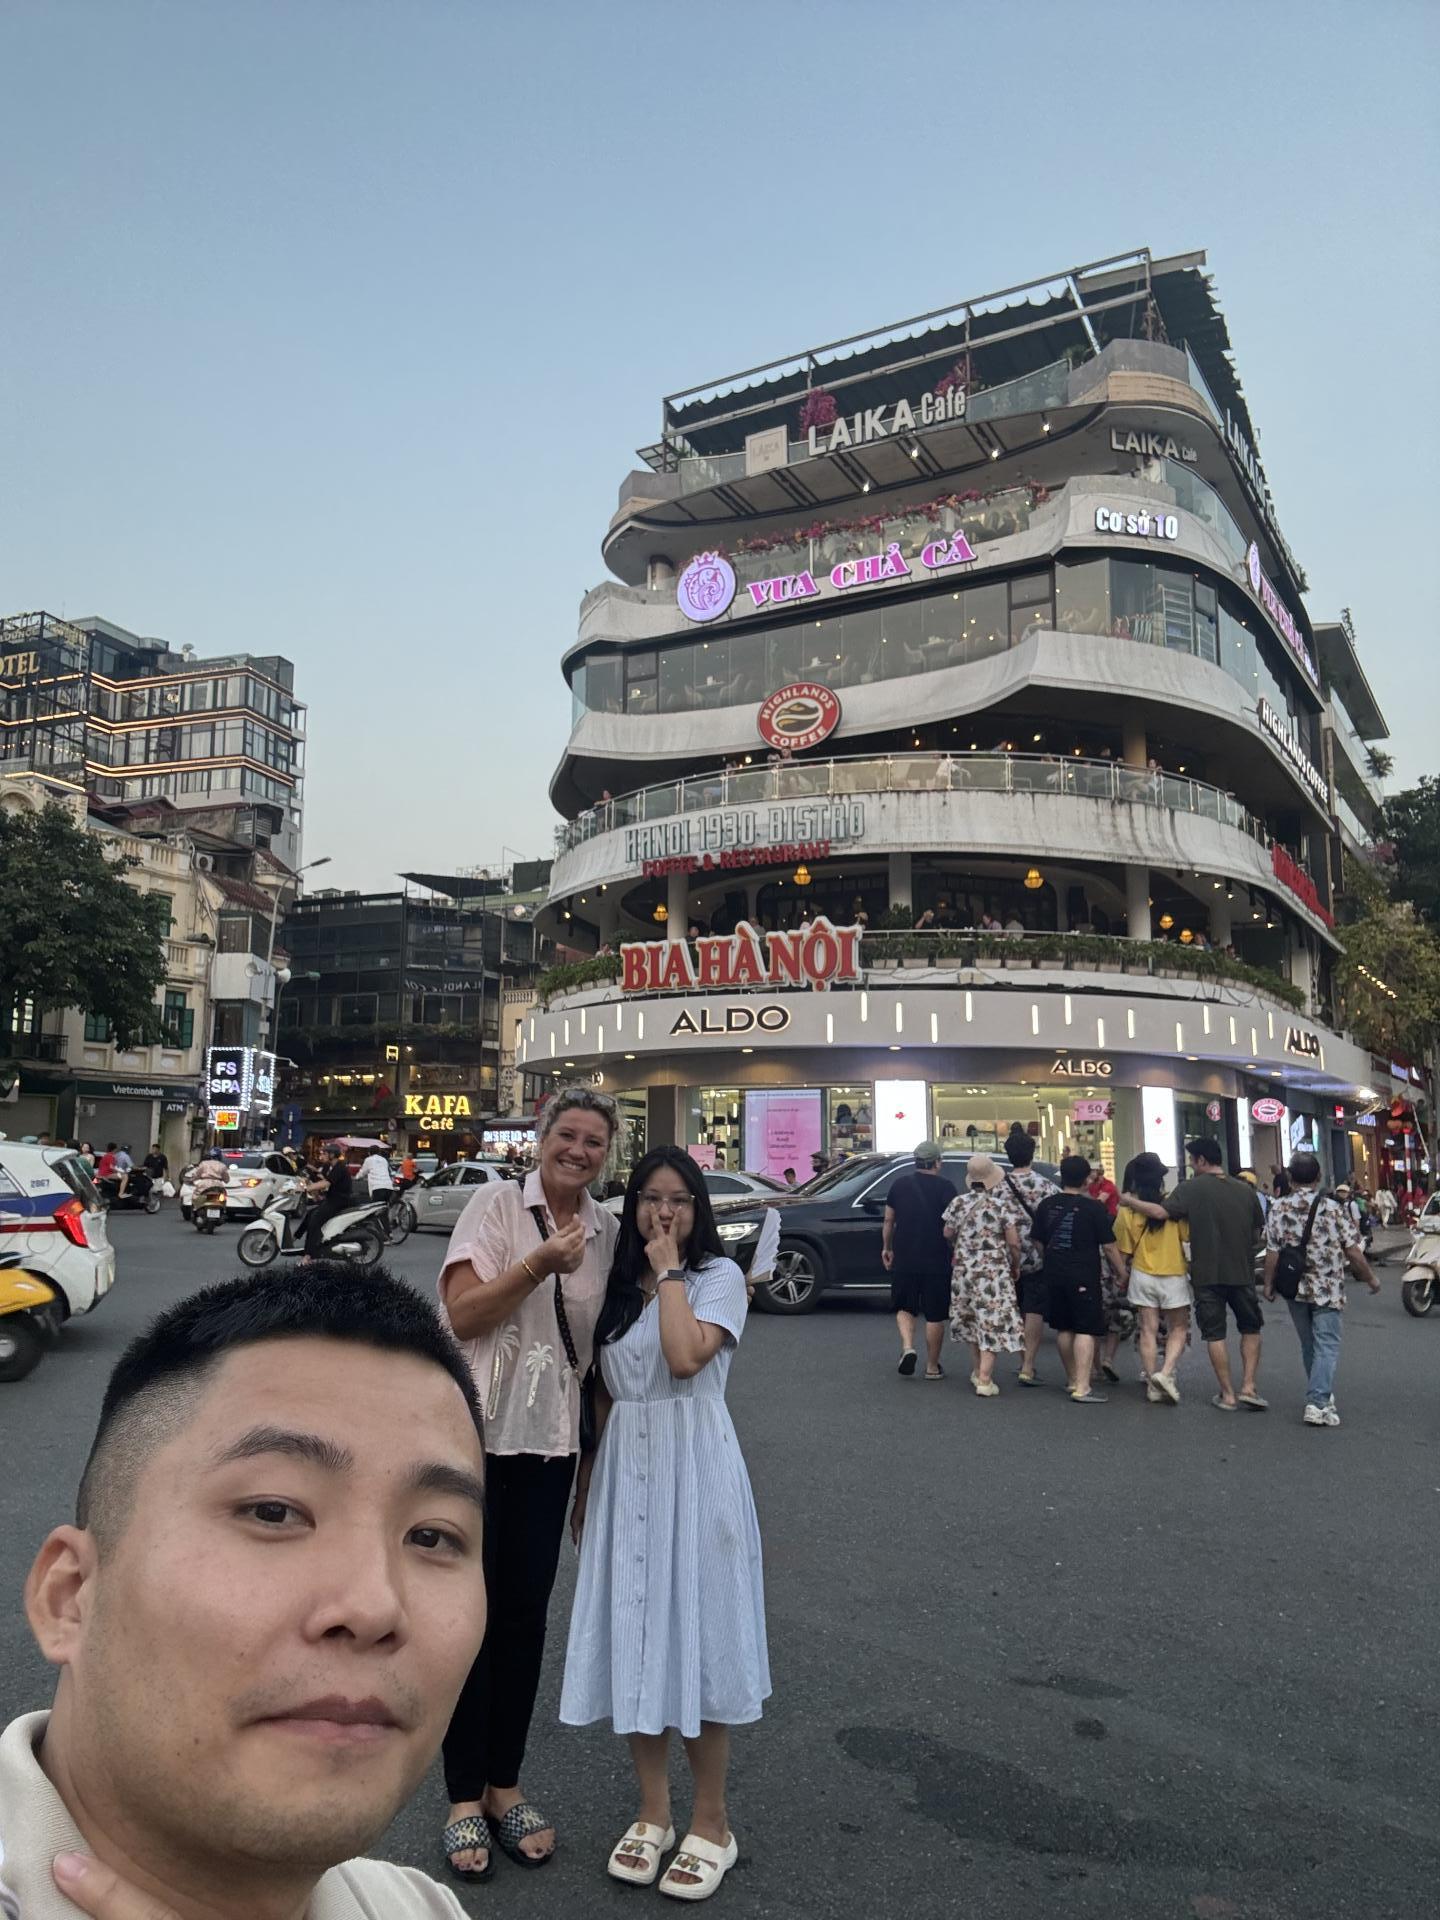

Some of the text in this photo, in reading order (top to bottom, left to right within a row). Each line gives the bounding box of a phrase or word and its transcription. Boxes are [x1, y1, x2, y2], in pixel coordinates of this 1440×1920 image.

[808, 385, 966, 456] LAIKA Café
[1110, 428, 1180, 459] LAIKA
[1155, 513, 1178, 539] 10
[747, 529, 978, 607] VUA CHẢ CÁ
[762, 686, 834, 719] HIGHLANDS
[771, 726, 826, 746] COFFEE
[1262, 699, 1306, 774] HIGHLANDS
[1307, 760, 1329, 804] COFFEE
[698, 811, 757, 851] 1930
[768, 802, 865, 843] BISTRO
[703, 853, 715, 871] &
[720, 840, 831, 868] RESTAURANT
[670, 1005, 791, 1036] ALDO
[1284, 1026, 1320, 1058] ALDO
[216, 1062, 237, 1076] FS
[1051, 1059, 1113, 1077] ALDO
[112, 1085, 164, 1097] Vietcombank
[211, 1079, 240, 1093] SPA
[166, 1104, 184, 1112] ATM
[404, 1094, 472, 1116] KAFA
[1087, 1104, 1103, 1114] 50
[419, 1116, 454, 1130] Café
